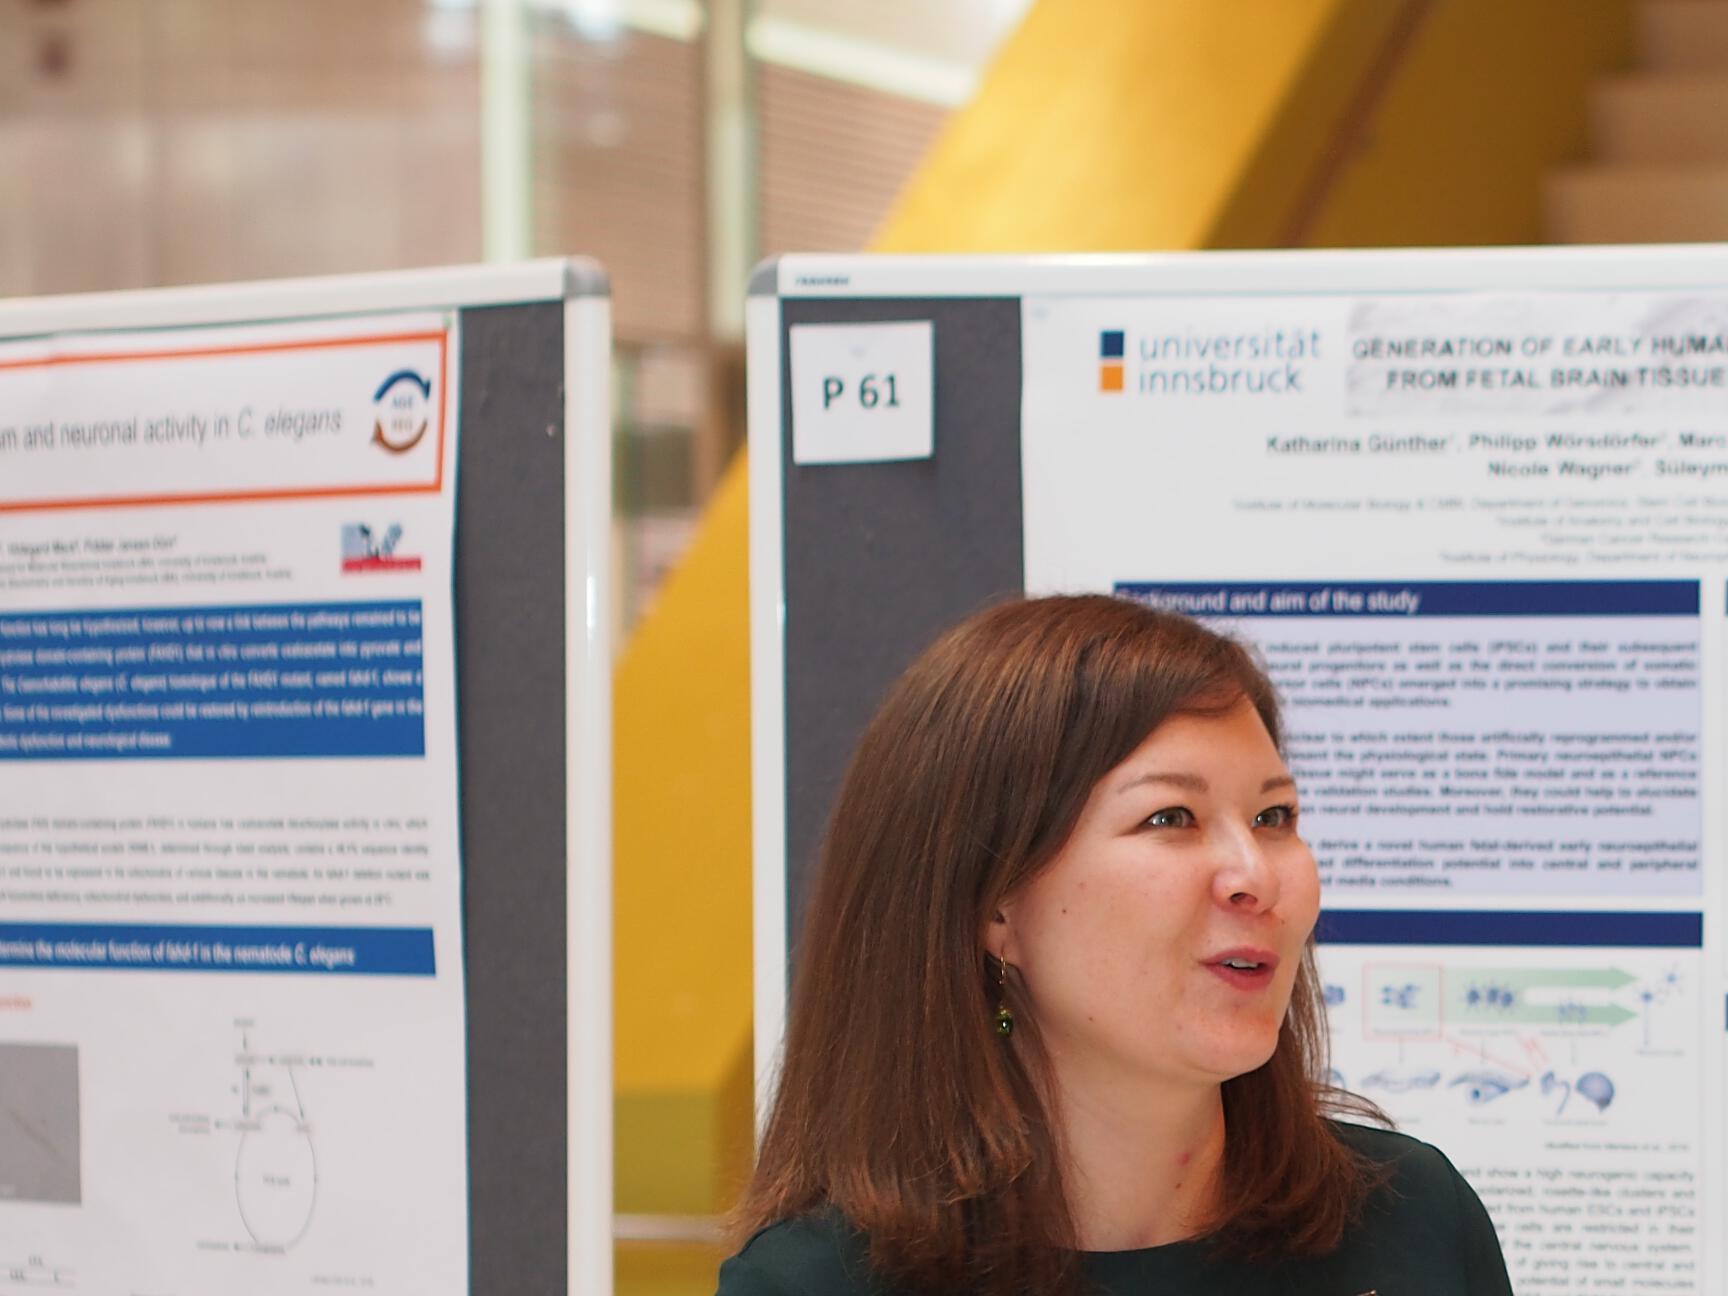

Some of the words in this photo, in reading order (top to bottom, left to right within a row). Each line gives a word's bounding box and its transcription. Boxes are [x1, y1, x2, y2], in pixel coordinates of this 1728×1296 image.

[1139, 329, 1321, 361] universität
[1353, 335, 1512, 359] GENERATION
[1521, 335, 1552, 357] OF
[1563, 334, 1644, 356] EARLY
[1139, 363, 1302, 394] innsbruck
[1387, 368, 1458, 390] FROM
[1466, 368, 1542, 389] FETAL
[1550, 368, 1629, 388] BRAIN
[1638, 366, 1724, 387] TISSUE
[821, 377, 846, 409] P
[858, 374, 901, 408] 61
[23, 421, 55, 448] and
[59, 422, 138, 446] neuronal
[144, 413, 207, 447] activity
[213, 413, 229, 437] in
[237, 407, 257, 438] C.
[265, 407, 342, 437] elegans
[1266, 436, 1361, 454] Katharina
[1469, 433, 1538, 451] Philipp
[1679, 432, 1727, 448] Marc
[1488, 460, 1548, 476] Nicole
[1230, 590, 1266, 612] and
[1270, 590, 1304, 612] aim
[1309, 589, 1330, 612] of
[1332, 590, 1362, 611] the
[1367, 590, 1420, 614] study
